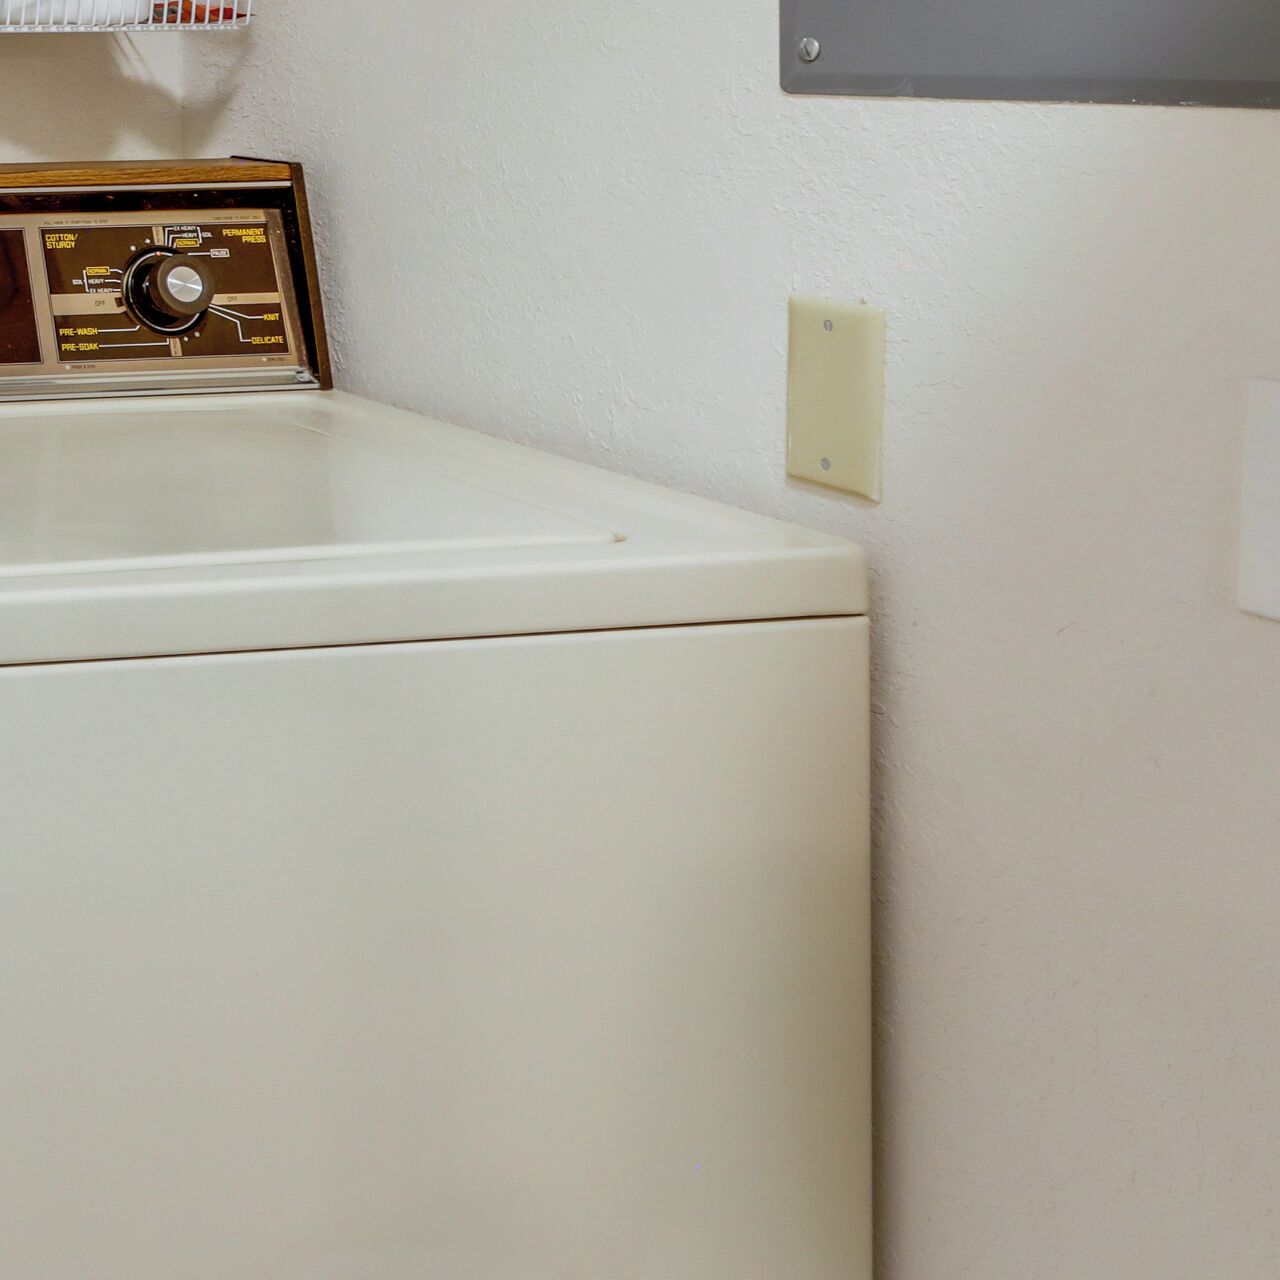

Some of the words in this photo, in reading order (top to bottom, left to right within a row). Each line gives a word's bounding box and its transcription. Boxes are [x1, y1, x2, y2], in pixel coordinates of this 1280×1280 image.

[222, 228, 265, 236] PERMANENT
[45, 233, 78, 242] COTTON/
[242, 235, 266, 243] PRESS
[46, 241, 76, 249] STURDY
[263, 313, 280, 321] KNIT
[60, 327, 98, 336] PRE-WASH
[251, 335, 284, 345] DELICATE
[61, 343, 99, 352] PRE-SOAK
